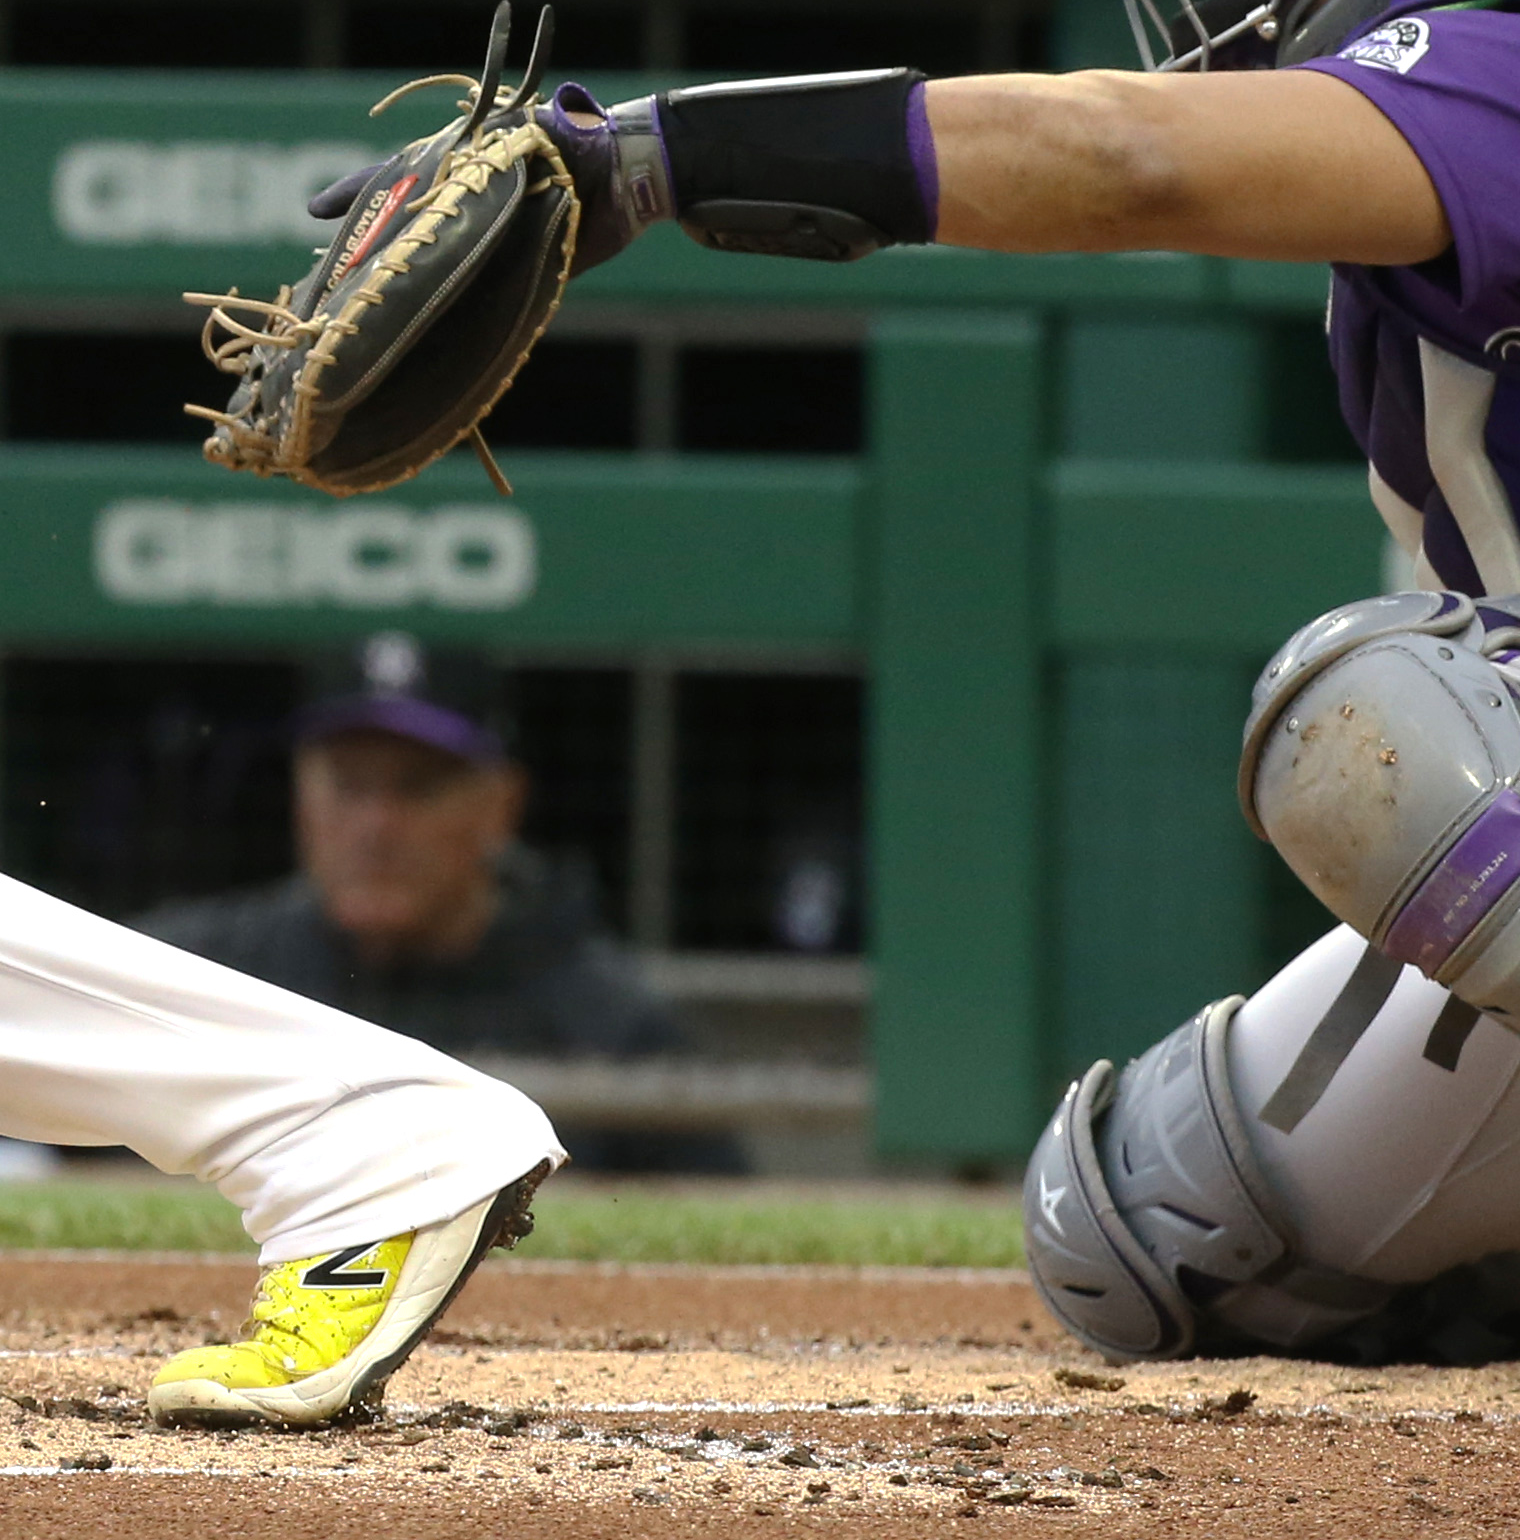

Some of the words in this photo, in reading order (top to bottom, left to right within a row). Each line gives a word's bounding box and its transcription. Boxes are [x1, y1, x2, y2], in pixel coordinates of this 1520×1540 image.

[52, 140, 384, 244] GEIC
[346, 207, 377, 253] GLOVE
[94, 498, 536, 610] GEICO
